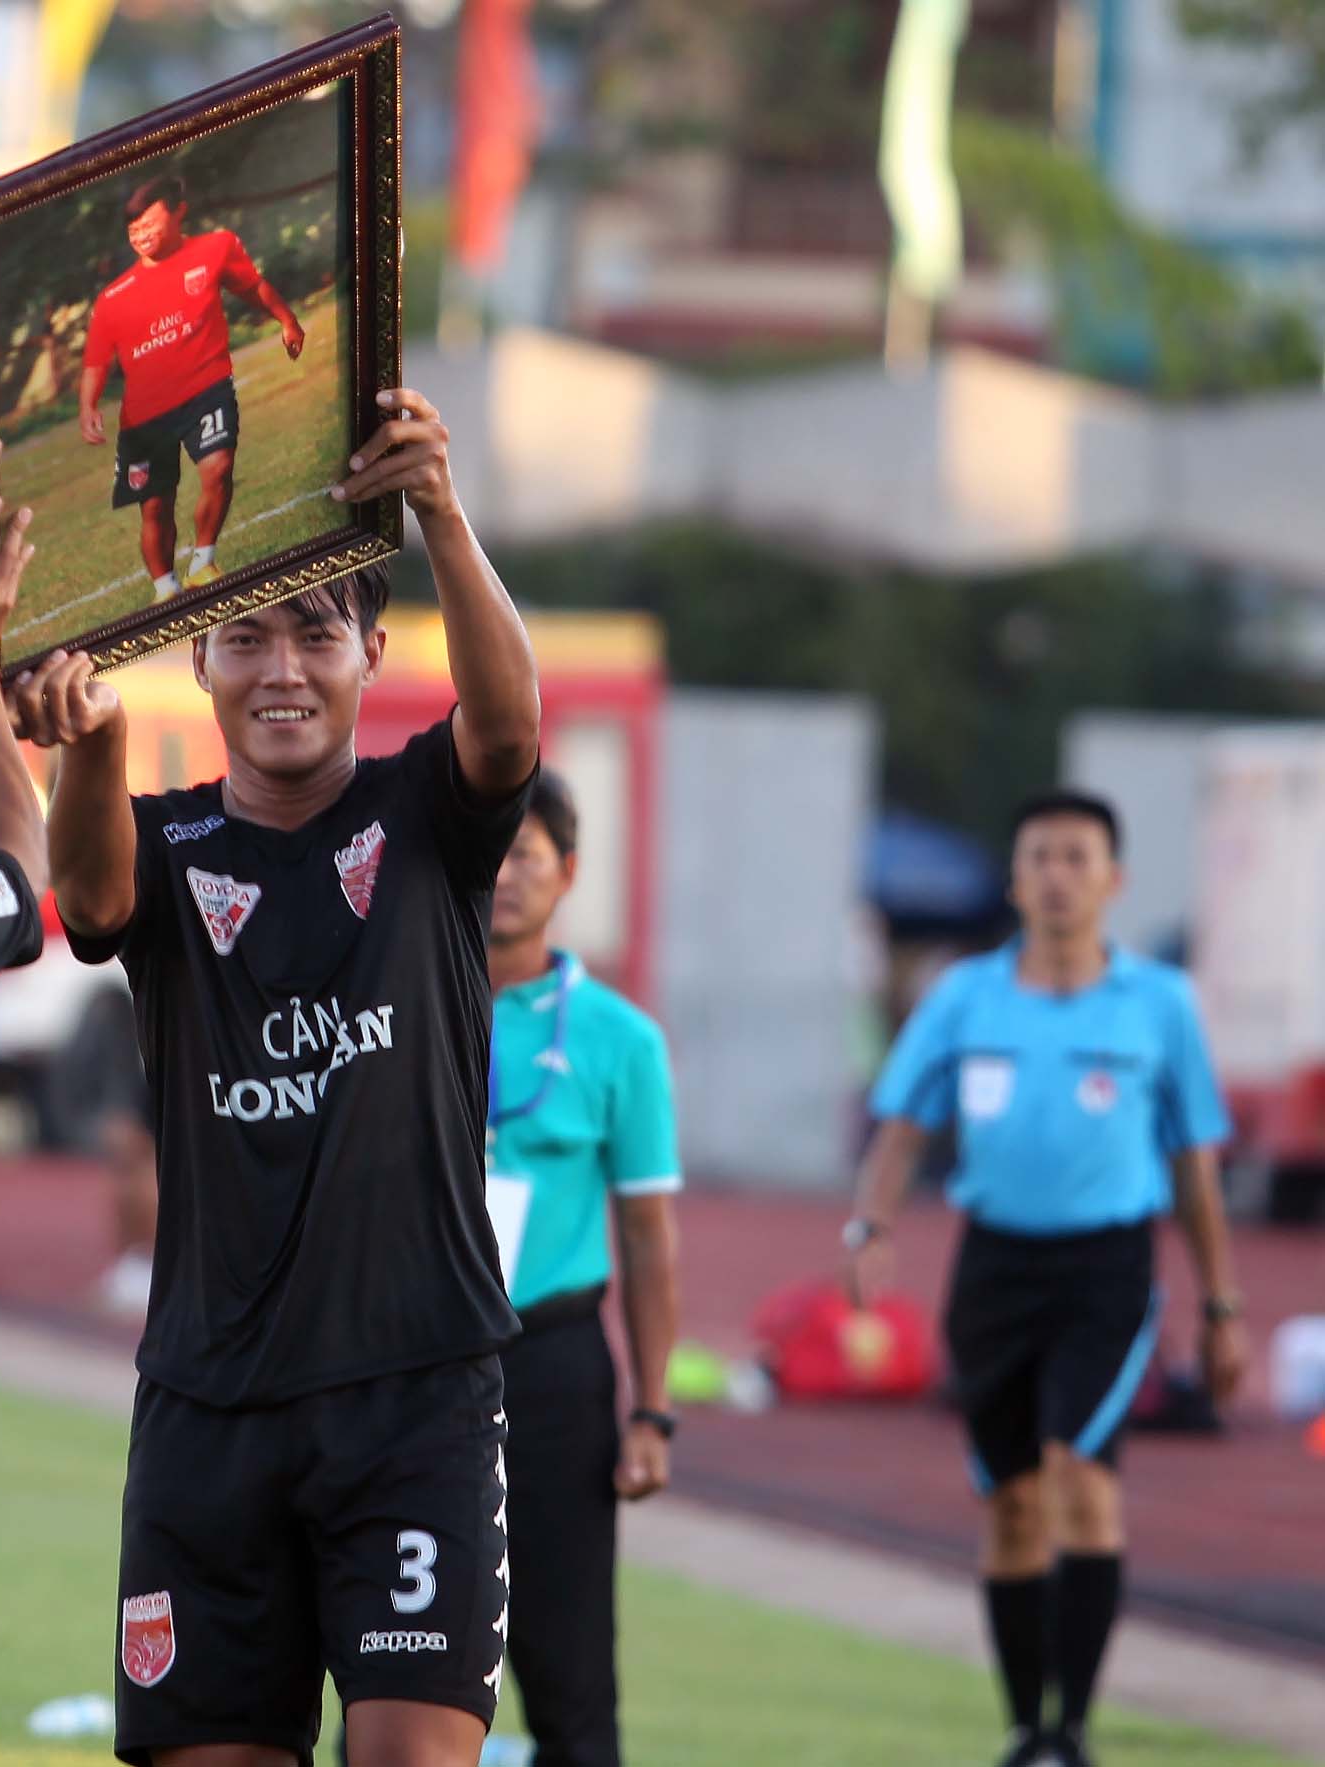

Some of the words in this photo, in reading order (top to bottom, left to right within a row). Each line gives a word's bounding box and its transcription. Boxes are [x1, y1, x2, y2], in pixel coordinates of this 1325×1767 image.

[200, 407, 224, 440] 21
[262, 996, 344, 1061] CẢN
[207, 1066, 330, 1122] LON
[390, 1528, 438, 1614] 3
[359, 1629, 448, 1653] Kappa
